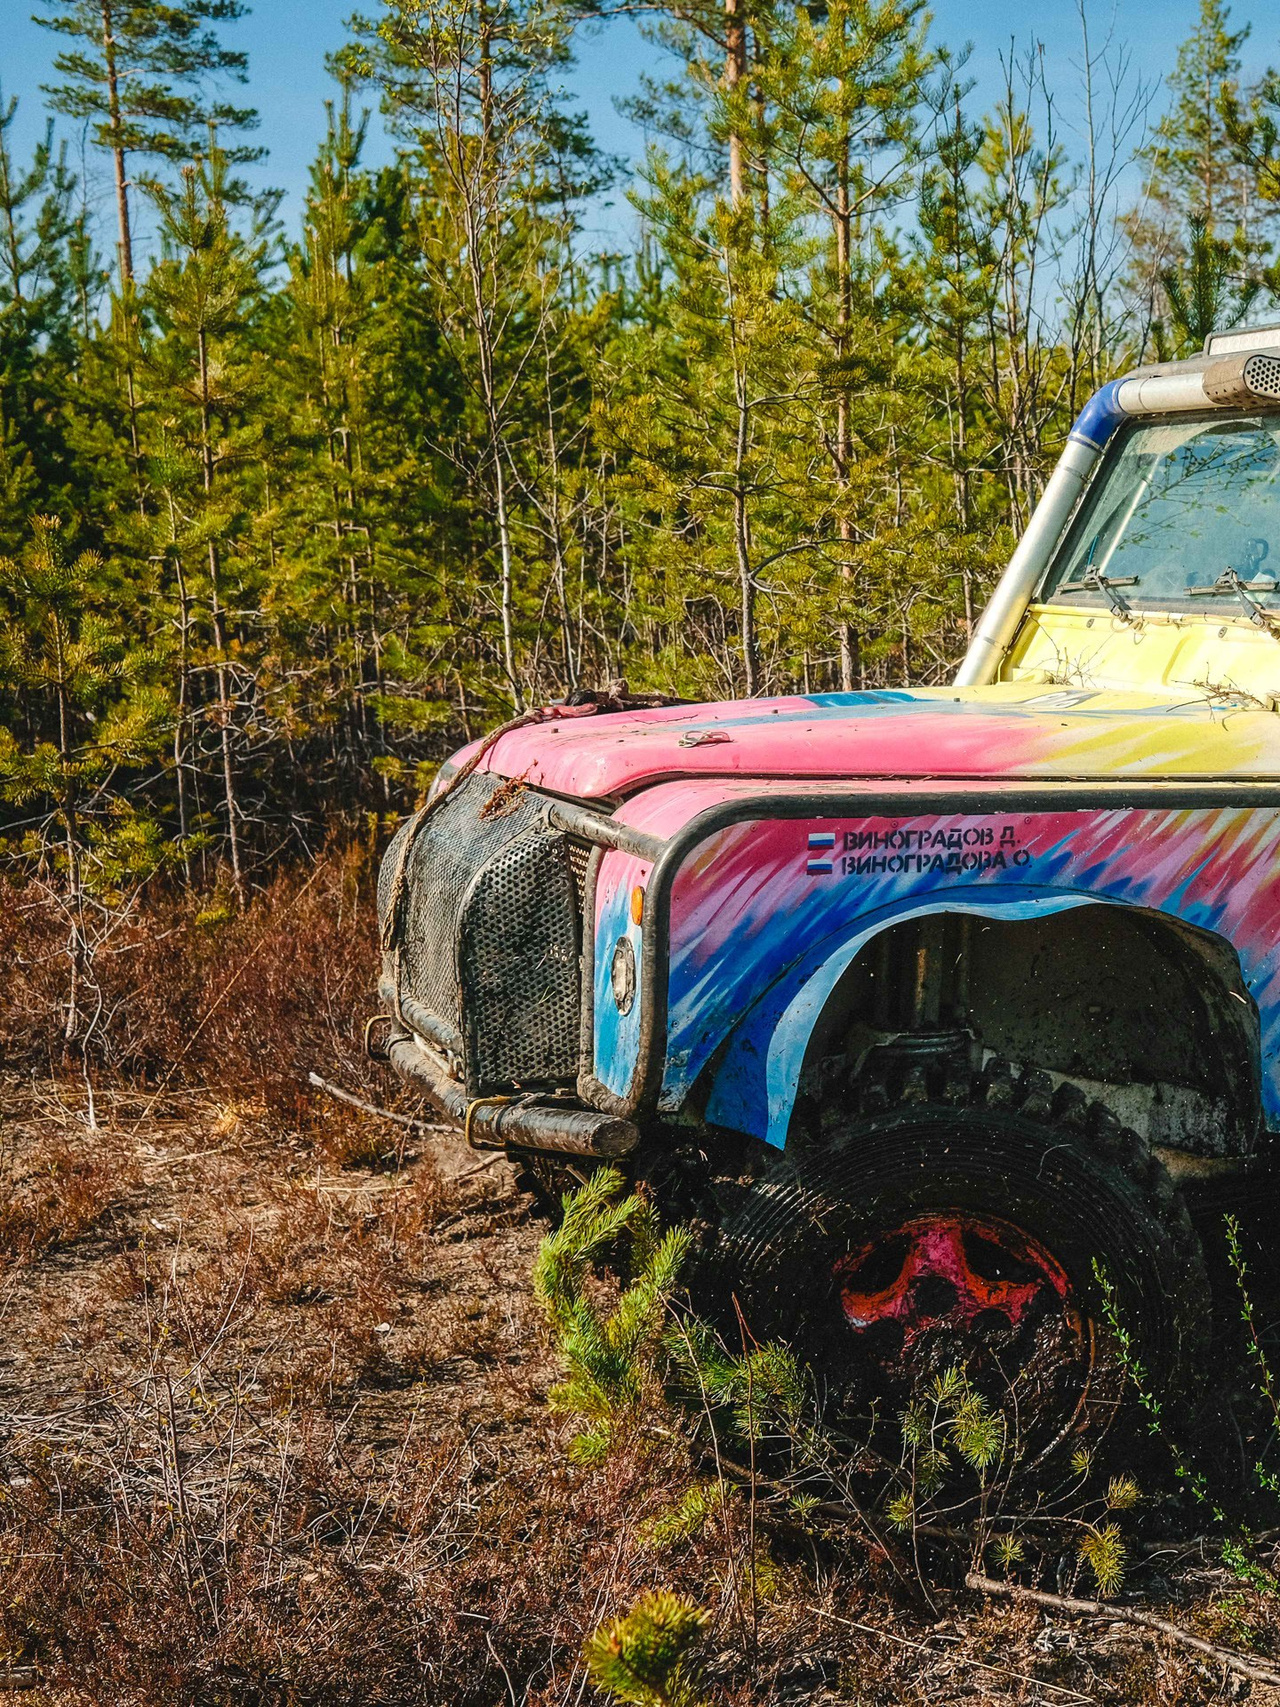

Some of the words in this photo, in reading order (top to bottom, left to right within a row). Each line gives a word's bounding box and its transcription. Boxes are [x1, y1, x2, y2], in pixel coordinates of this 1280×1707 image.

[842, 827, 994, 851] ВИНОГРАДОВ
[1000, 825, 1021, 848] Д.
[841, 850, 1007, 875] ВИНОГРАДОВА
